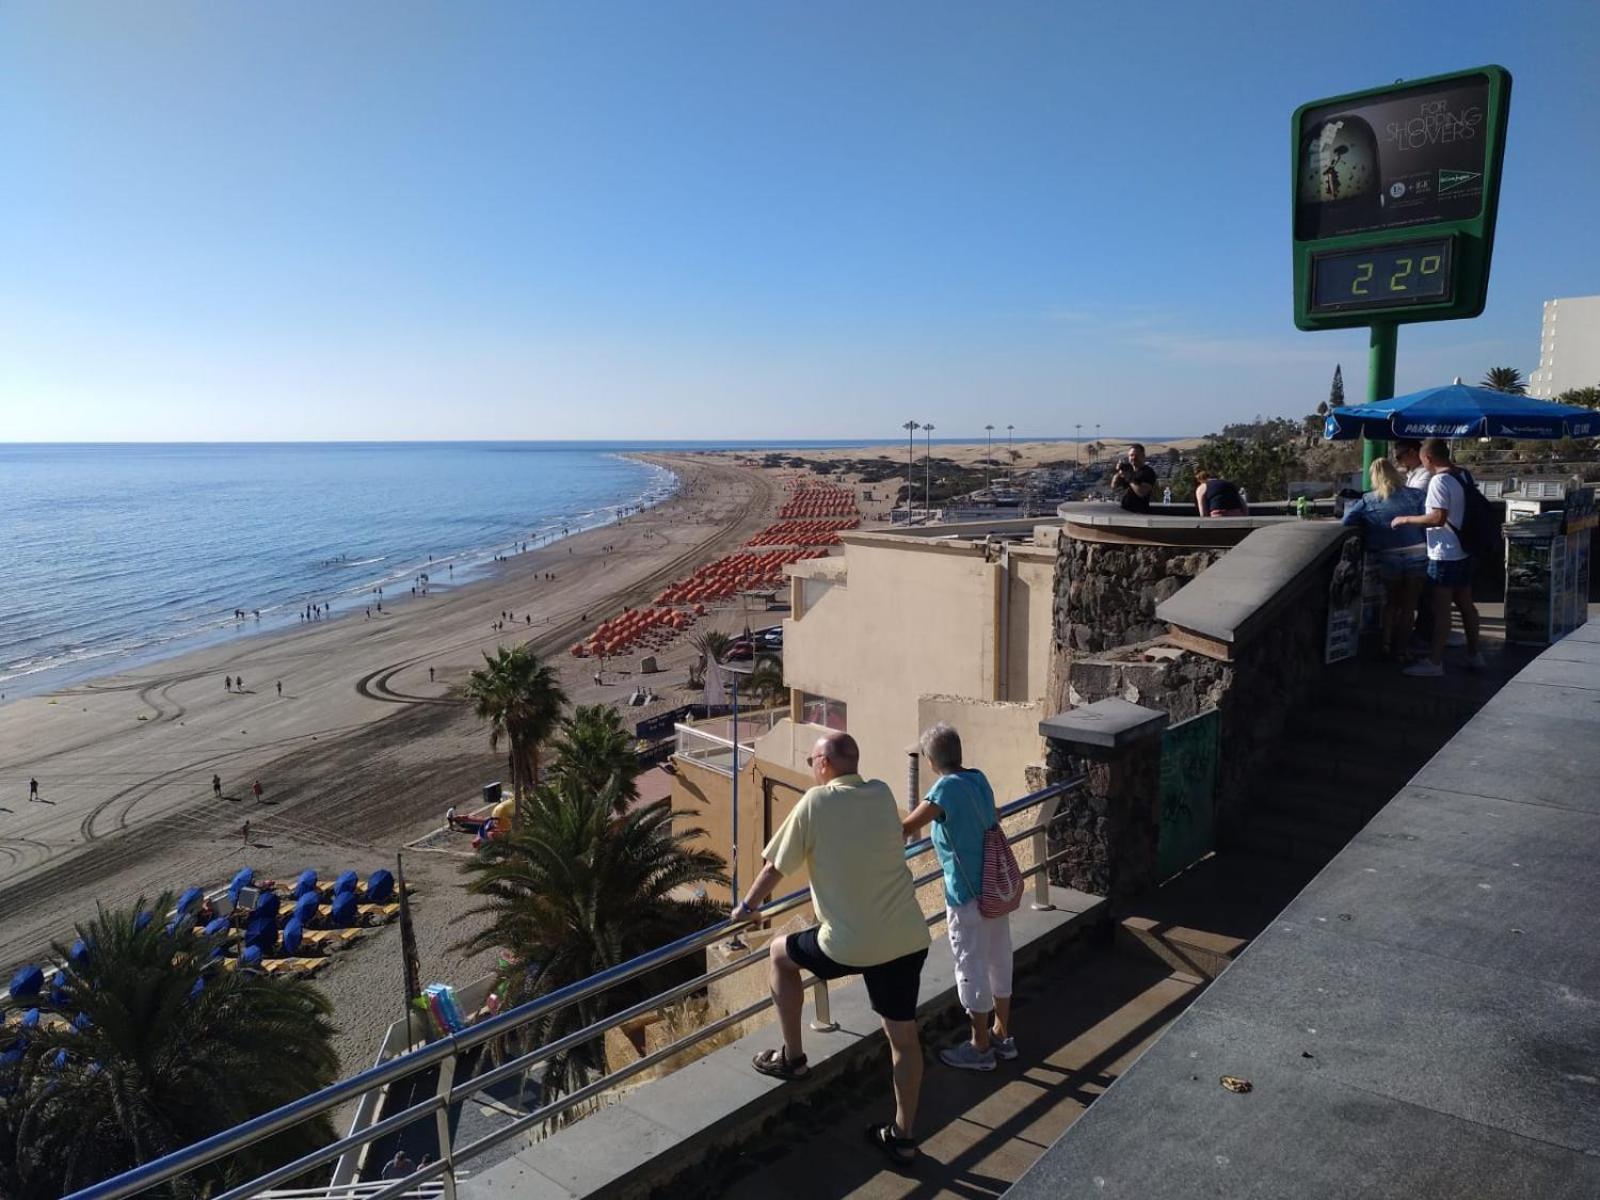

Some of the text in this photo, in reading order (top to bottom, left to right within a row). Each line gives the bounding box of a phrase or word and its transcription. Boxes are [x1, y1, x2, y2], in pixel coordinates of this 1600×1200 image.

[1420, 99, 1448, 117] FOR
[1383, 107, 1483, 143] SHOPPING
[1399, 120, 1476, 151] LOVERS
